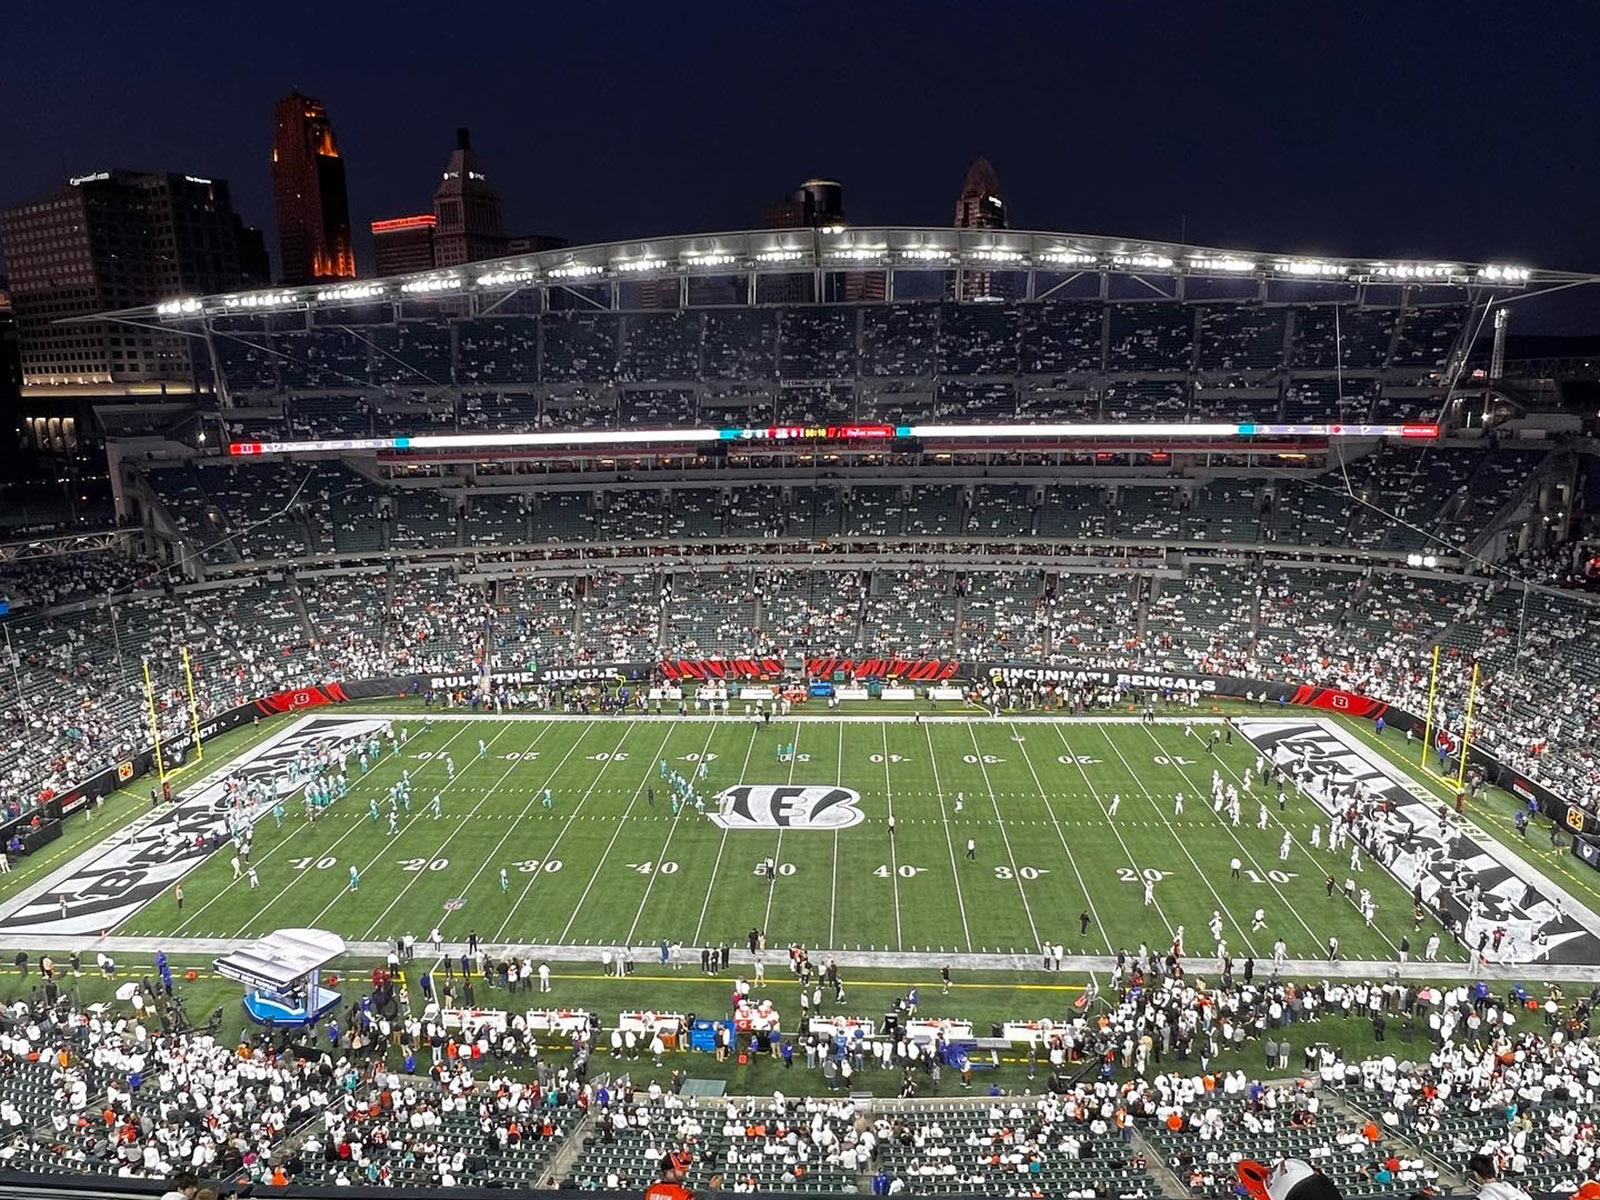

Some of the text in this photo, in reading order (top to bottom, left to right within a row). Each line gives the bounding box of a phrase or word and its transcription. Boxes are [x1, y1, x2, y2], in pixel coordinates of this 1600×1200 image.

[493, 671, 534, 685] THE
[541, 667, 619, 682] JUNGLE
[988, 667, 1217, 692] CINCINNATI BENGALS
[293, 856, 337, 870] 10
[402, 858, 449, 872] 20
[520, 860, 564, 873] 30
[635, 861, 679, 874] 40
[753, 863, 797, 876] 50
[873, 864, 916, 878] 40
[994, 866, 1040, 879] 30
[1116, 868, 1164, 881] 20
[1244, 870, 1291, 883] 10
